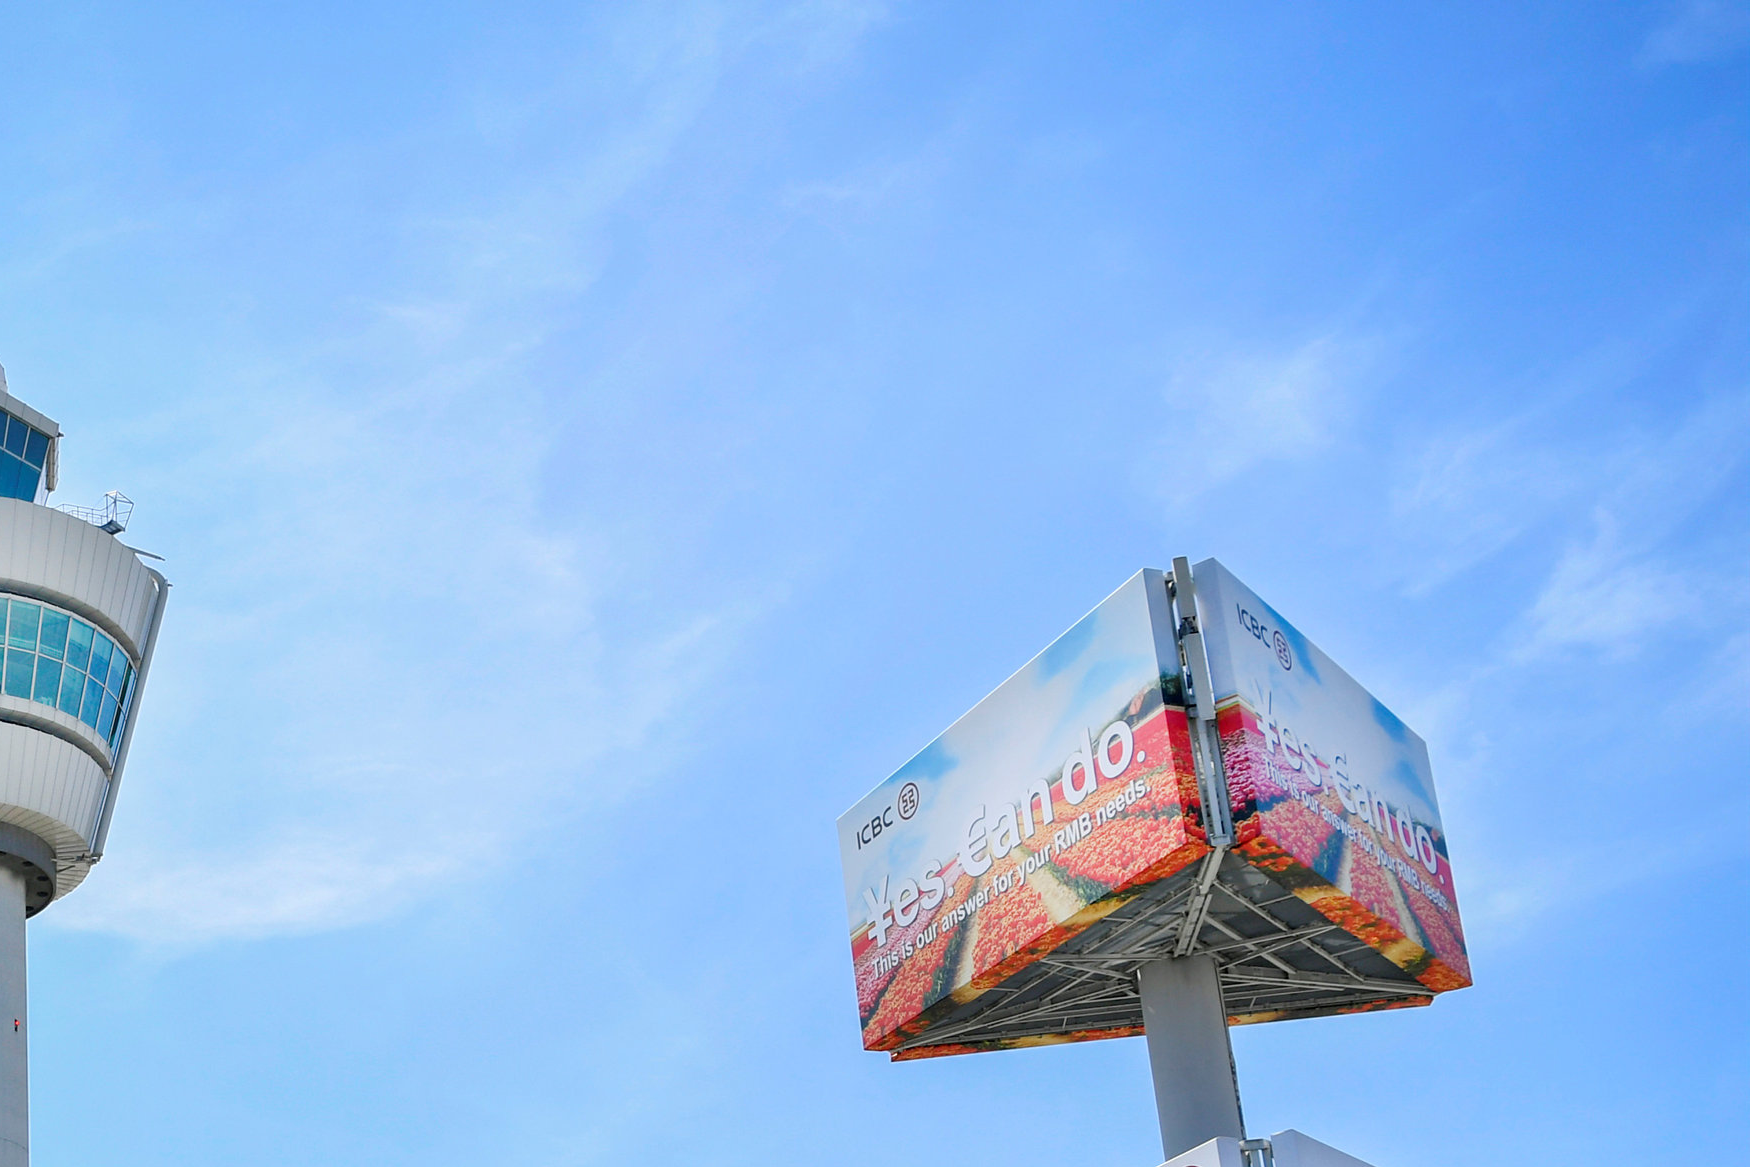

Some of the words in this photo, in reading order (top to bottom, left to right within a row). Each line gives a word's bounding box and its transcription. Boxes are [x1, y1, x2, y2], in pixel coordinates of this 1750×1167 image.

[1236, 603, 1271, 648] ICBC
[1062, 720, 1146, 806] do.
[856, 806, 893, 850] ICBC
[1263, 756, 1288, 792] This
[1288, 779, 1300, 800] is
[1302, 790, 1320, 816] our
[1322, 805, 1357, 842] answer
[1359, 831, 1374, 856] for
[1376, 847, 1396, 874] your
[1398, 859, 1421, 892] RMB
[1396, 803, 1446, 885] do.
[872, 950, 899, 979] This
[901, 941, 914, 960] is
[916, 923, 938, 949] our
[941, 887, 993, 933] answer
[993, 868, 1017, 896] for
[1017, 844, 1051, 885] your
[1054, 812, 1093, 854] RMB
[1096, 778, 1153, 826] needs.
